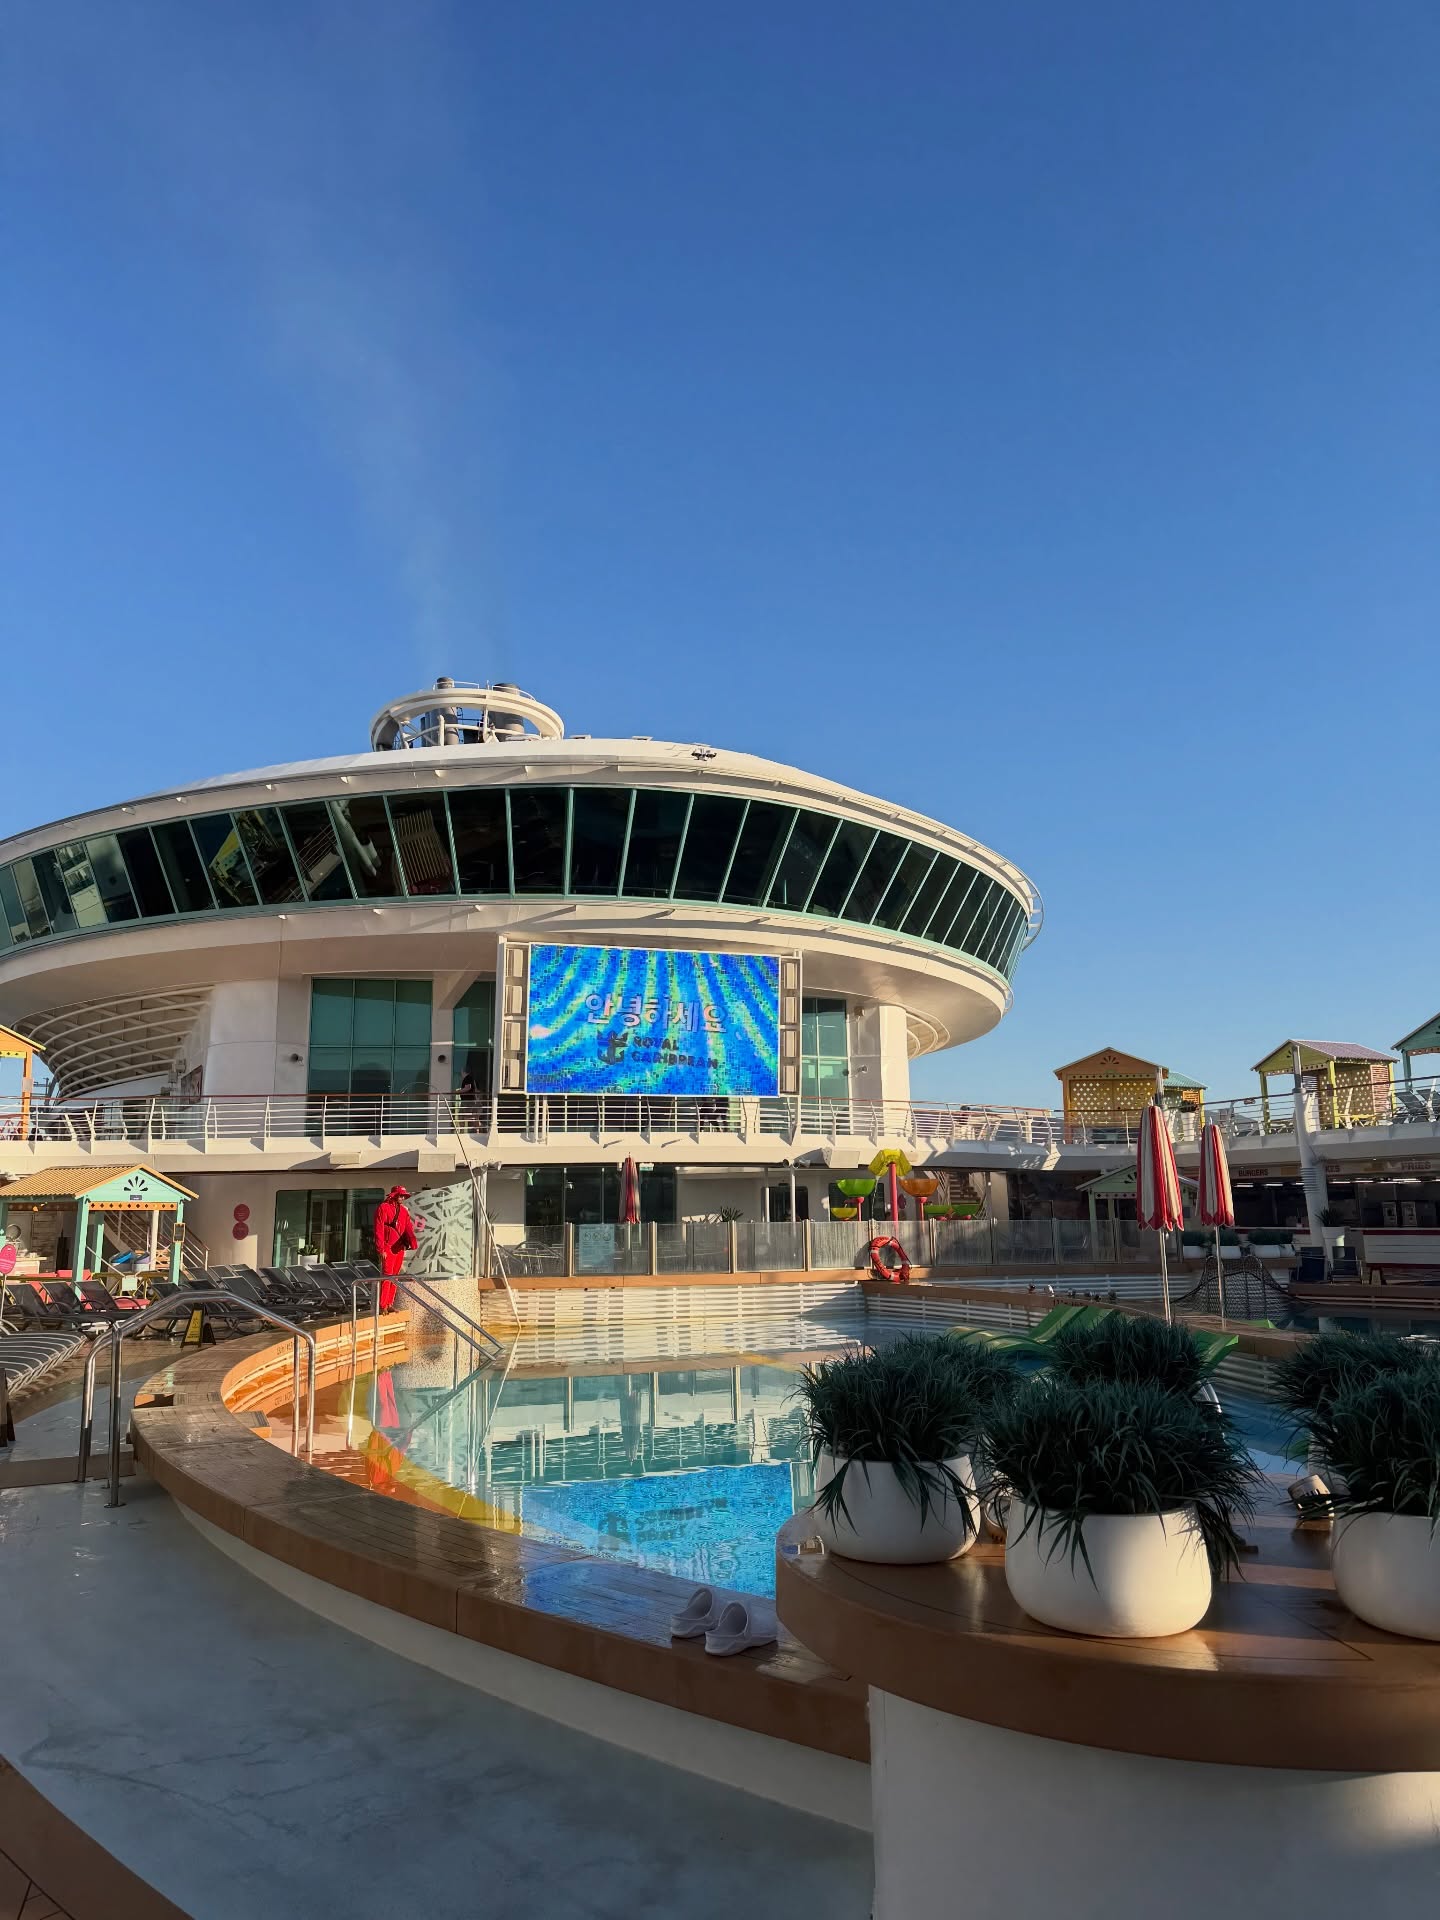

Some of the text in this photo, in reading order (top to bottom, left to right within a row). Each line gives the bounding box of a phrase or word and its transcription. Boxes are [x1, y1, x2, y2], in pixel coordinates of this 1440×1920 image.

[586, 993, 727, 1033] 안녕하세요
[1326, 1165, 1341, 1173] KES
[1401, 1161, 1431, 1170] FRIES
[1238, 1168, 1269, 1177] BURGERS
